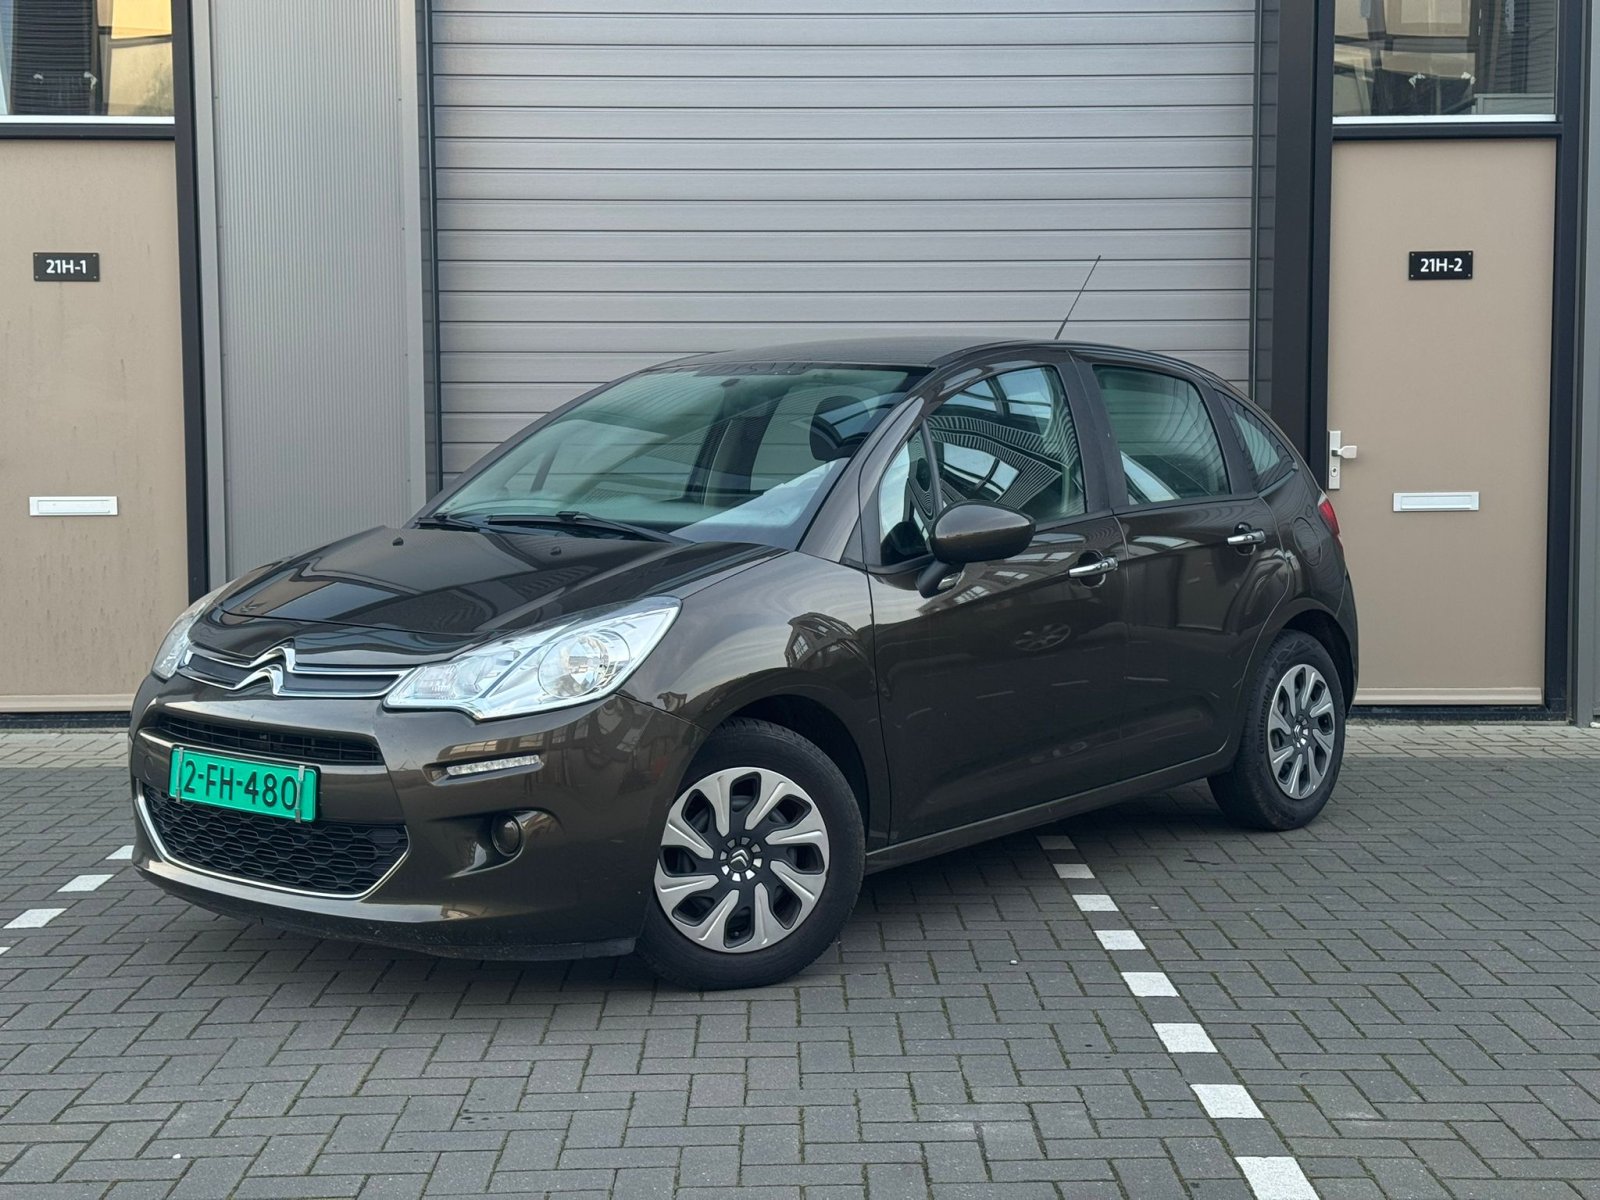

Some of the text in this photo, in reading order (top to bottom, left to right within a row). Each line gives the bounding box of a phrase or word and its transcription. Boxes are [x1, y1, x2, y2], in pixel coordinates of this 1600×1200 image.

[46, 259, 87, 274] 21H-1
[1420, 257, 1463, 272] 21H-2
[184, 760, 298, 810] 2-FH-480
